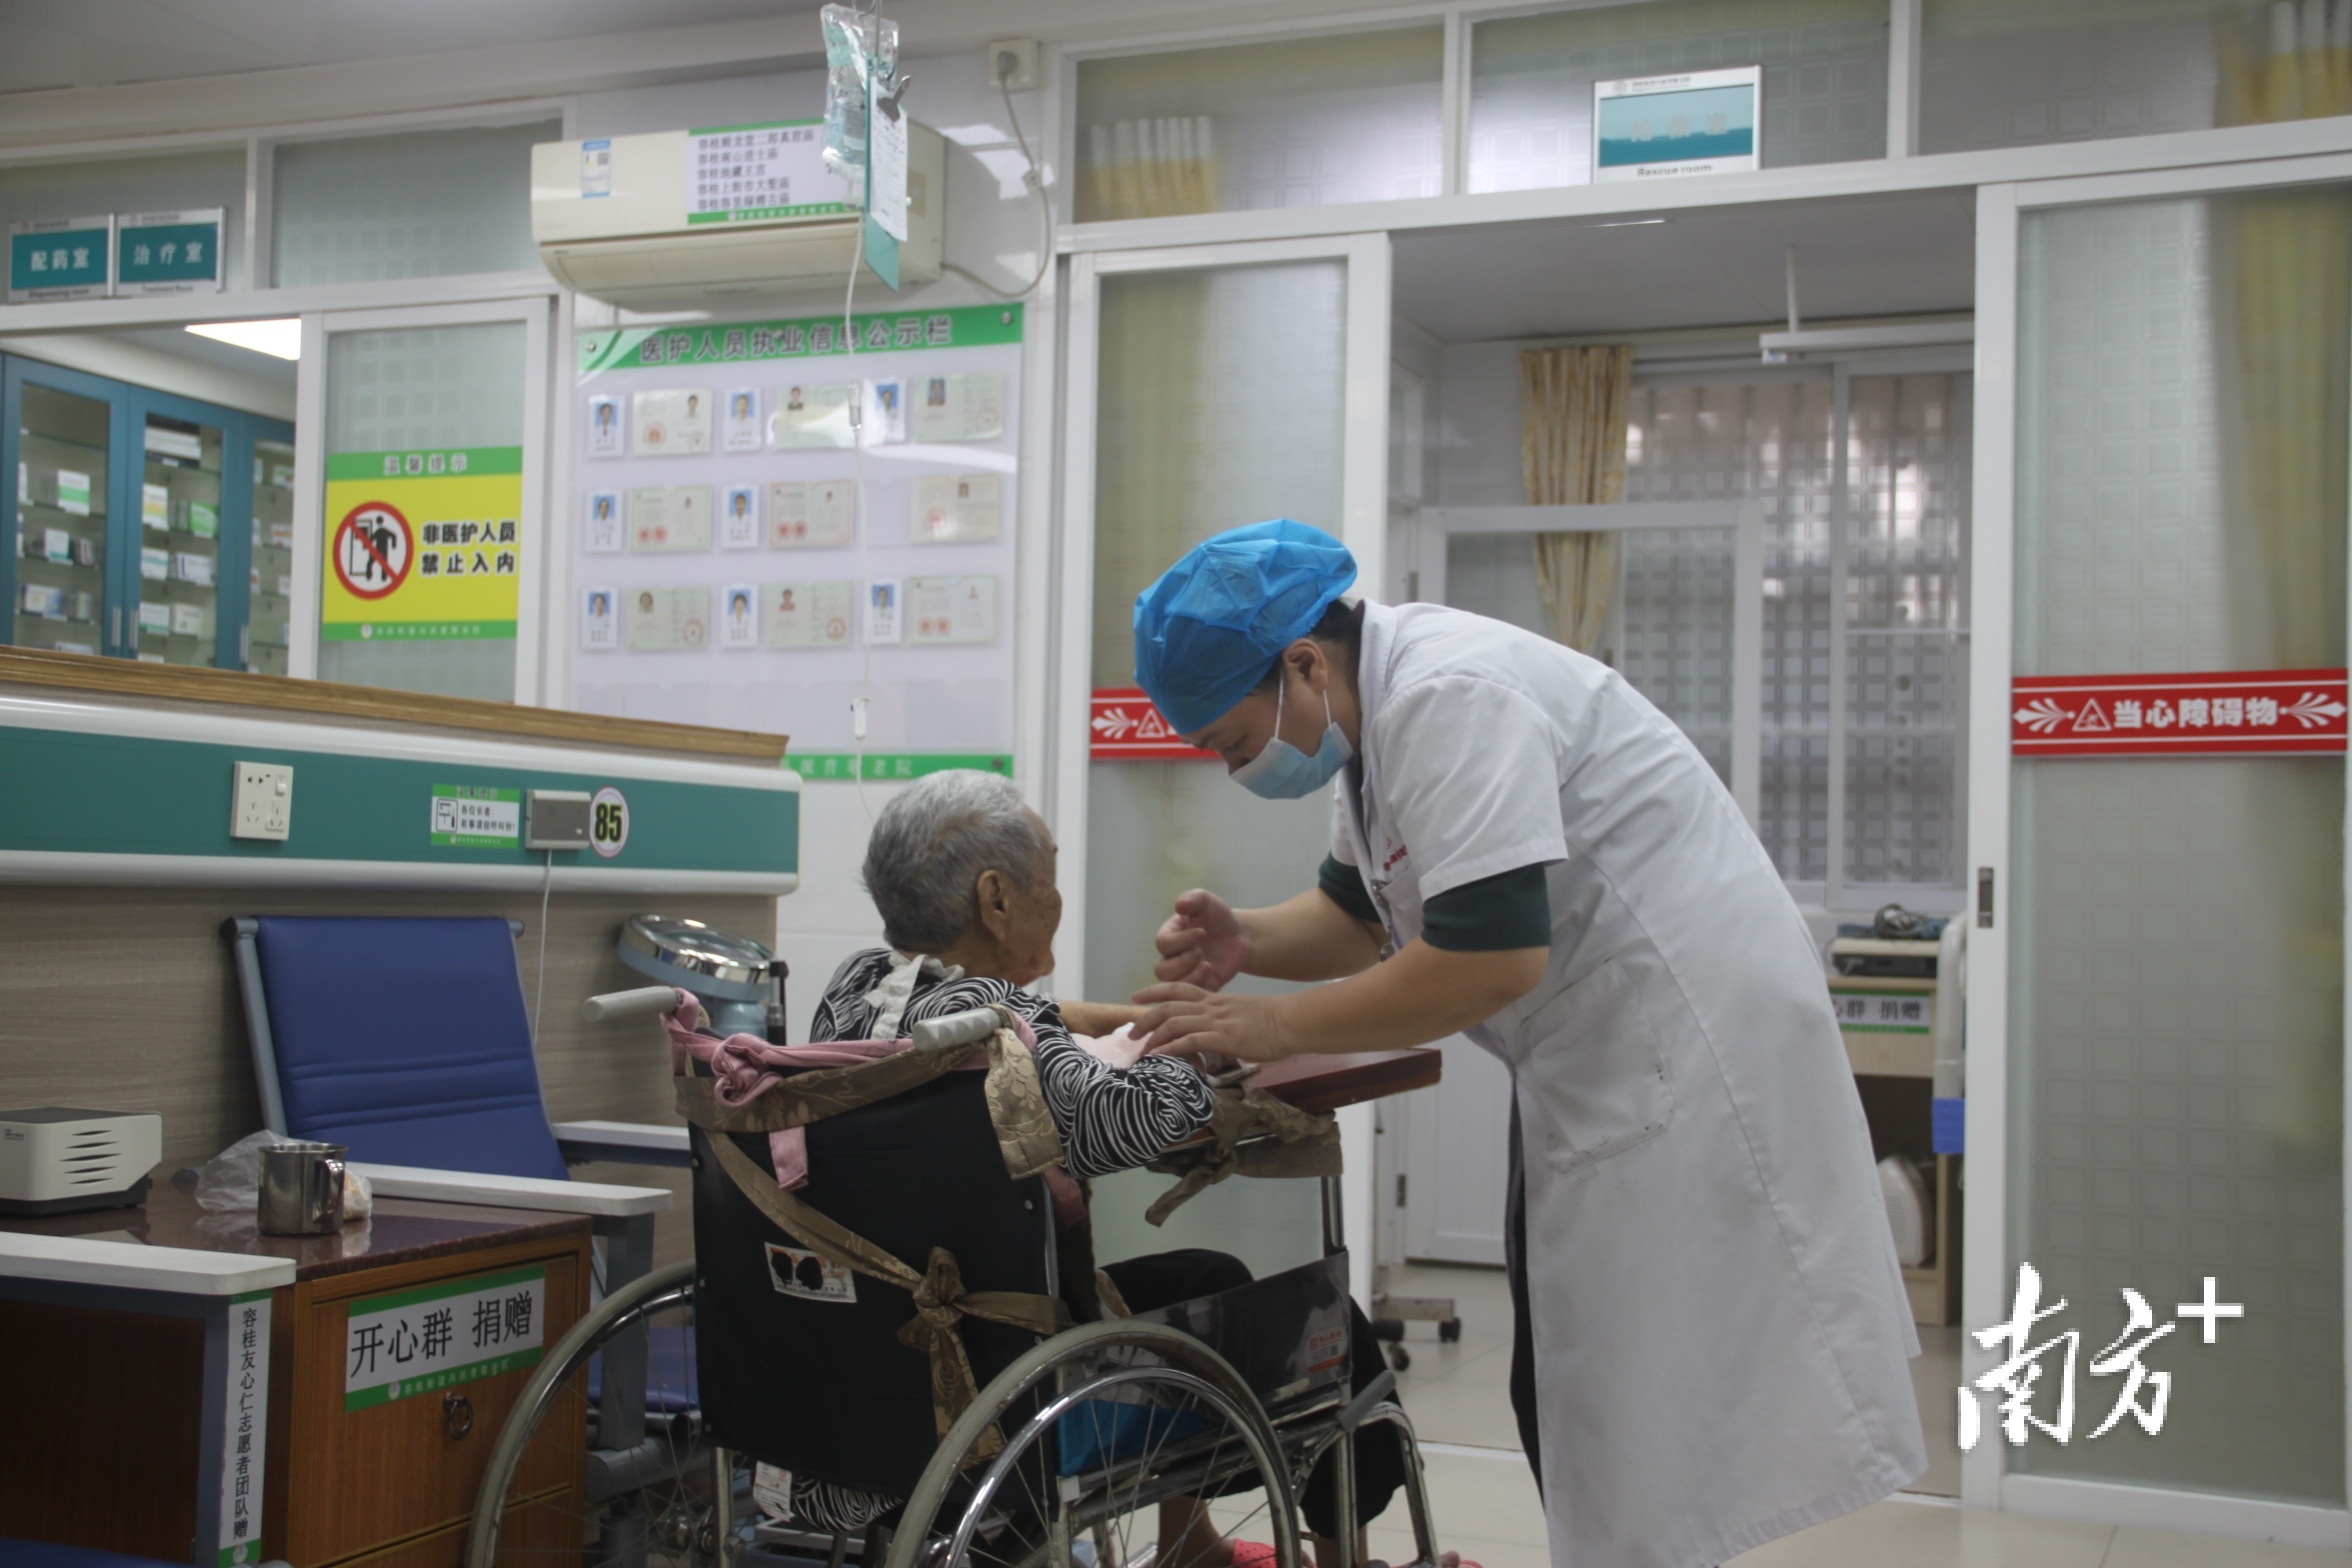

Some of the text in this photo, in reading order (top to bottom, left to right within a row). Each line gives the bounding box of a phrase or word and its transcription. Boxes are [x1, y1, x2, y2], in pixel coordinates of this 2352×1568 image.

[1637, 163, 1712, 178] Rescue room
[31, 246, 90, 272] 配药室
[134, 240, 203, 266] 治疗室
[640, 317, 951, 363] 医护人员执业信息公示栏
[385, 454, 467, 475] 温馨提示
[422, 520, 515, 545] 非医护人员
[421, 551, 514, 575] 禁止入内
[2113, 697, 2279, 729] 当心障碍物
[594, 802, 623, 842] 85
[350, 1289, 533, 1380] 开心群 捐赠
[232, 1307, 258, 1541] 容桂友心仁志愿者团队赠
